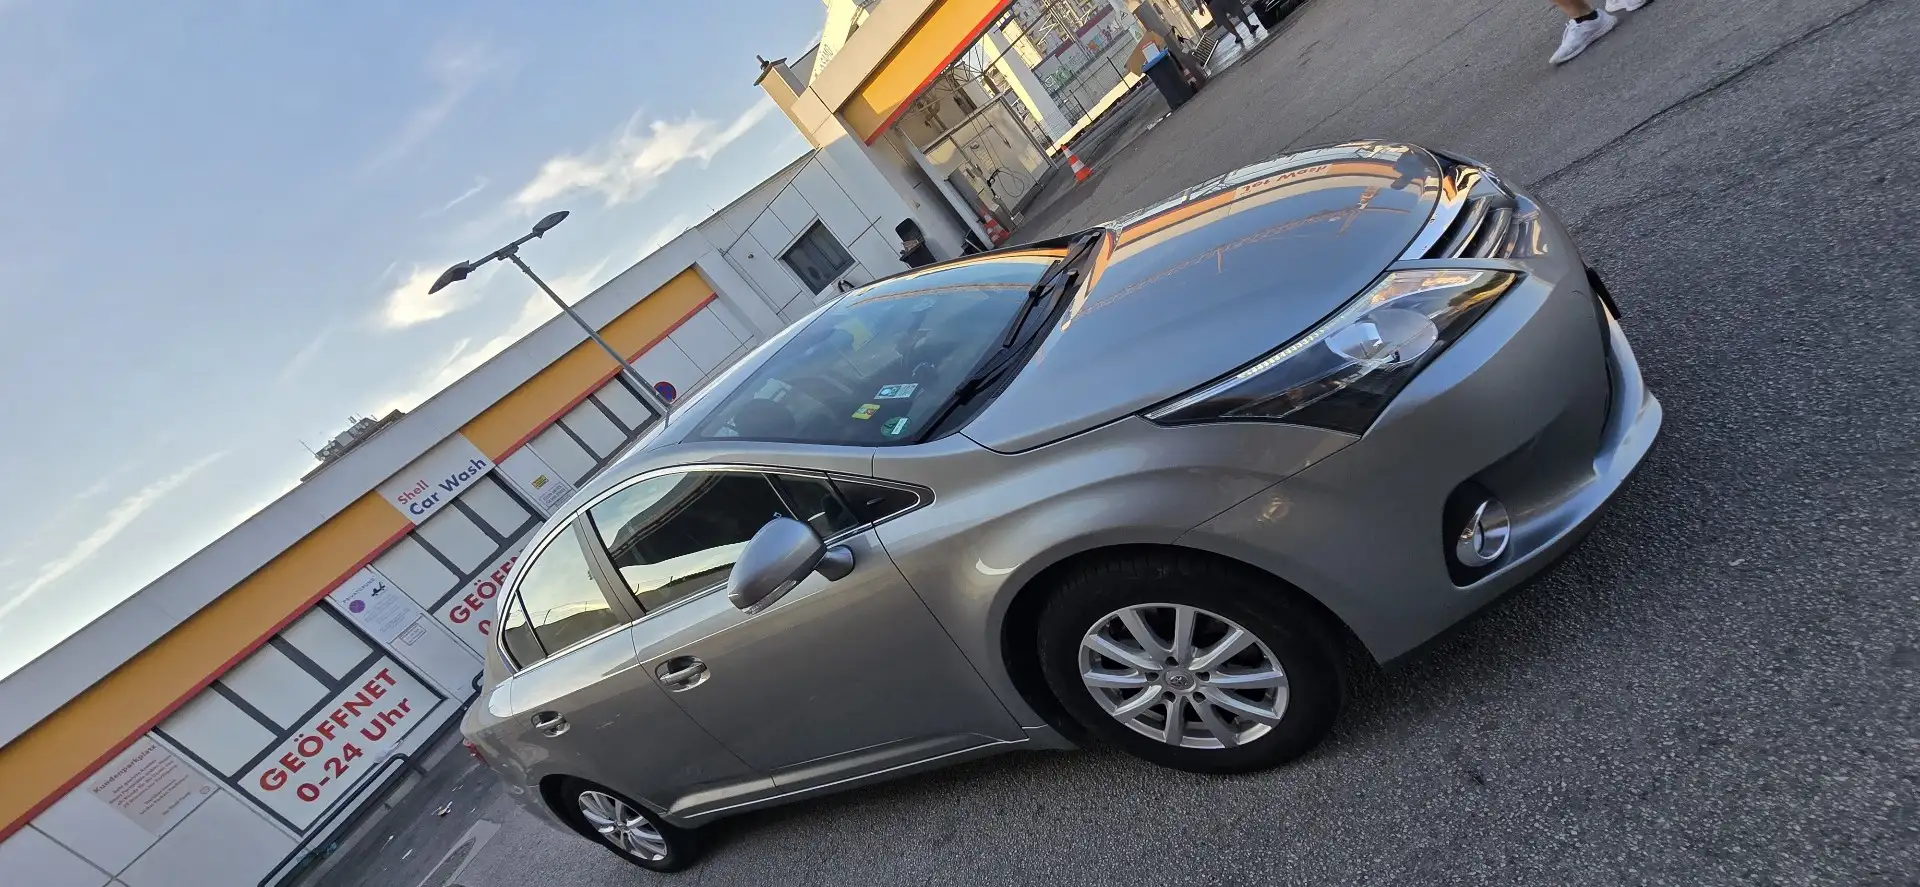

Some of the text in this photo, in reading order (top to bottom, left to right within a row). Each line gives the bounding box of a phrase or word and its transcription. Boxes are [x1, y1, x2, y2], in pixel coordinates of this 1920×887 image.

[398, 480, 429, 505] Shell
[409, 459, 487, 515] Car Wash
[259, 667, 397, 791] GEÖFFNET
[296, 698, 411, 803] 0-24 Uhr
[93, 744, 157, 794] Kundenparkplatz
